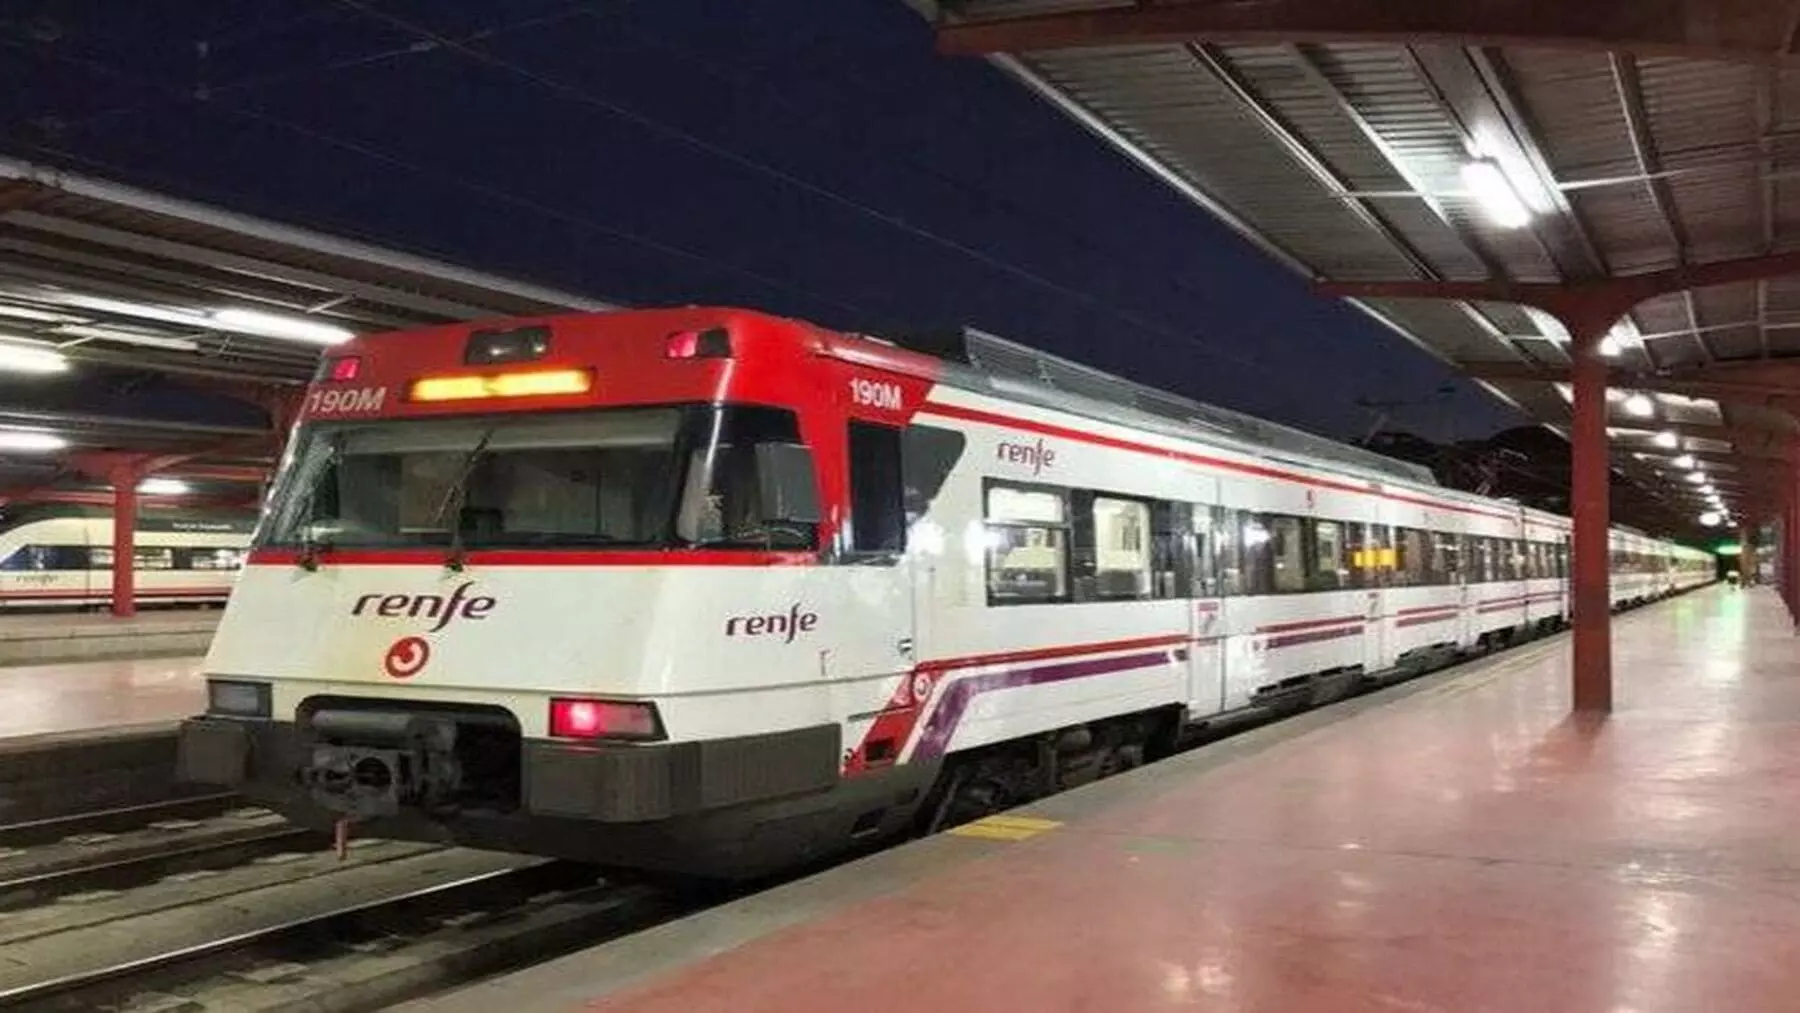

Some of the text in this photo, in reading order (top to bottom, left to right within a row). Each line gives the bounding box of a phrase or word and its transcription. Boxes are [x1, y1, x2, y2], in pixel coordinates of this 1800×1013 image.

[310, 386, 387, 412] 190M
[850, 378, 901, 409] 190M
[997, 438, 1055, 475] renfe
[352, 581, 496, 632] renfe
[726, 602, 818, 644] renfe
